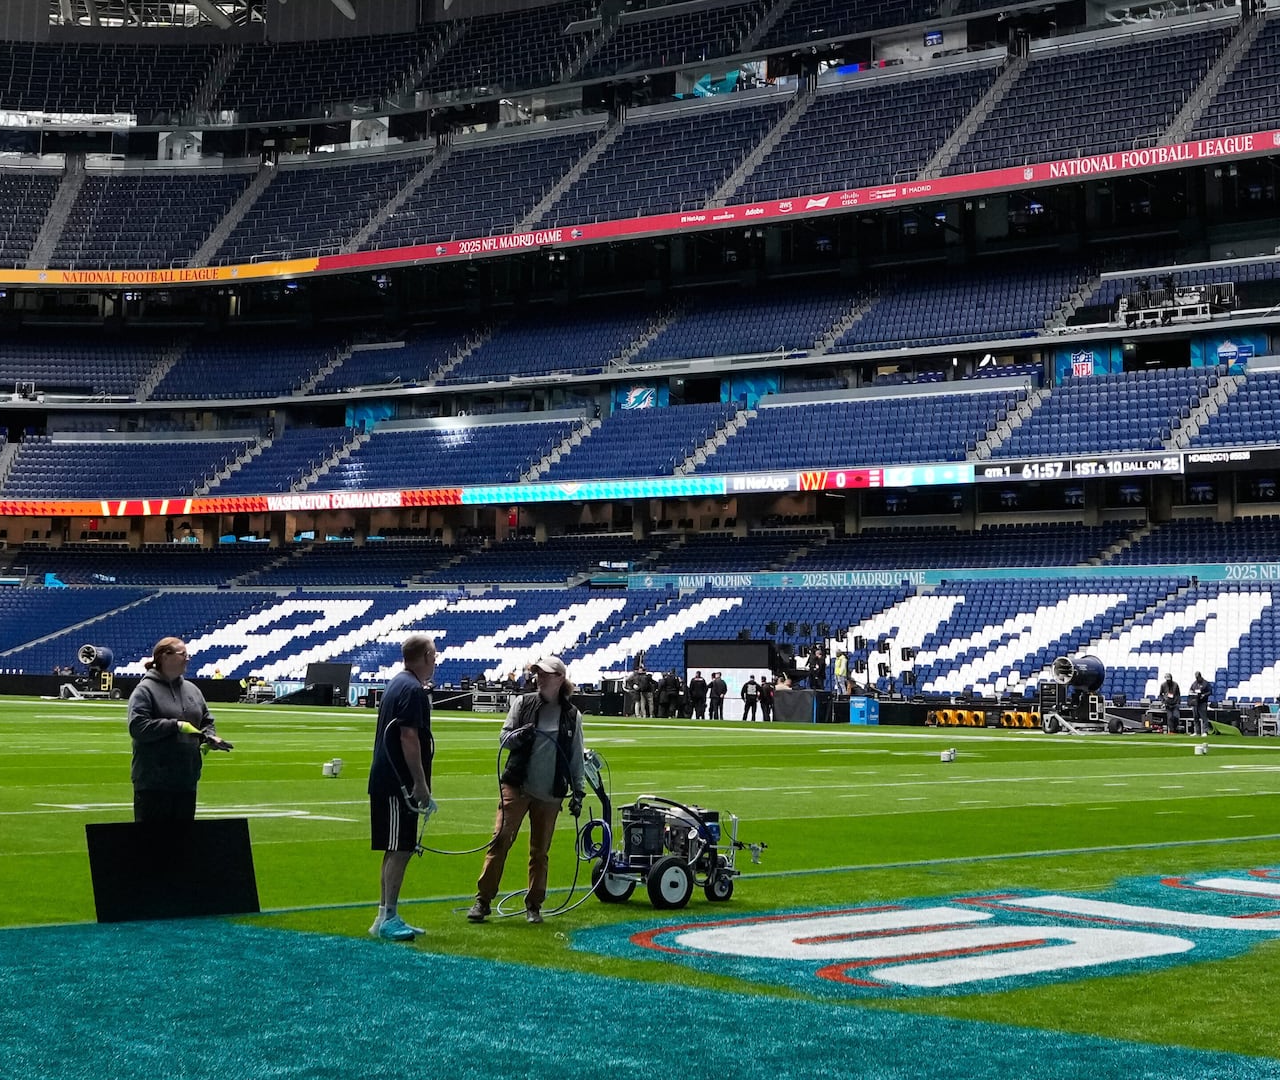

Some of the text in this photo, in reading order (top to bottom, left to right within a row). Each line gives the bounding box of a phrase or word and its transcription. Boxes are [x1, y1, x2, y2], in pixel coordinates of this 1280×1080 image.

[1050, 135, 1254, 178] NATIONAL FOOTBALL LEAGUE
[909, 185, 931, 193] MADRID
[745, 207, 765, 216] Adobe
[459, 230, 562, 253] 2025 NFL MADRID GAME
[62, 268, 219, 283] NATIONAL FOOTBALL LEAGUE
[1073, 362, 1092, 377] NFL
[984, 462, 1064, 479] QTR 1 61:57
[1075, 457, 1180, 476] 1ST & 10 BALL ON 25
[746, 476, 789, 491] NetApp
[835, 472, 846, 488] 0
[267, 492, 401, 511] WASHINGTON COMMANDERS
[802, 571, 926, 586] 2025 NFL MADRID GAME
[1225, 565, 1258, 580] 2025
[678, 574, 752, 587] MIAMI DOLPHINS
